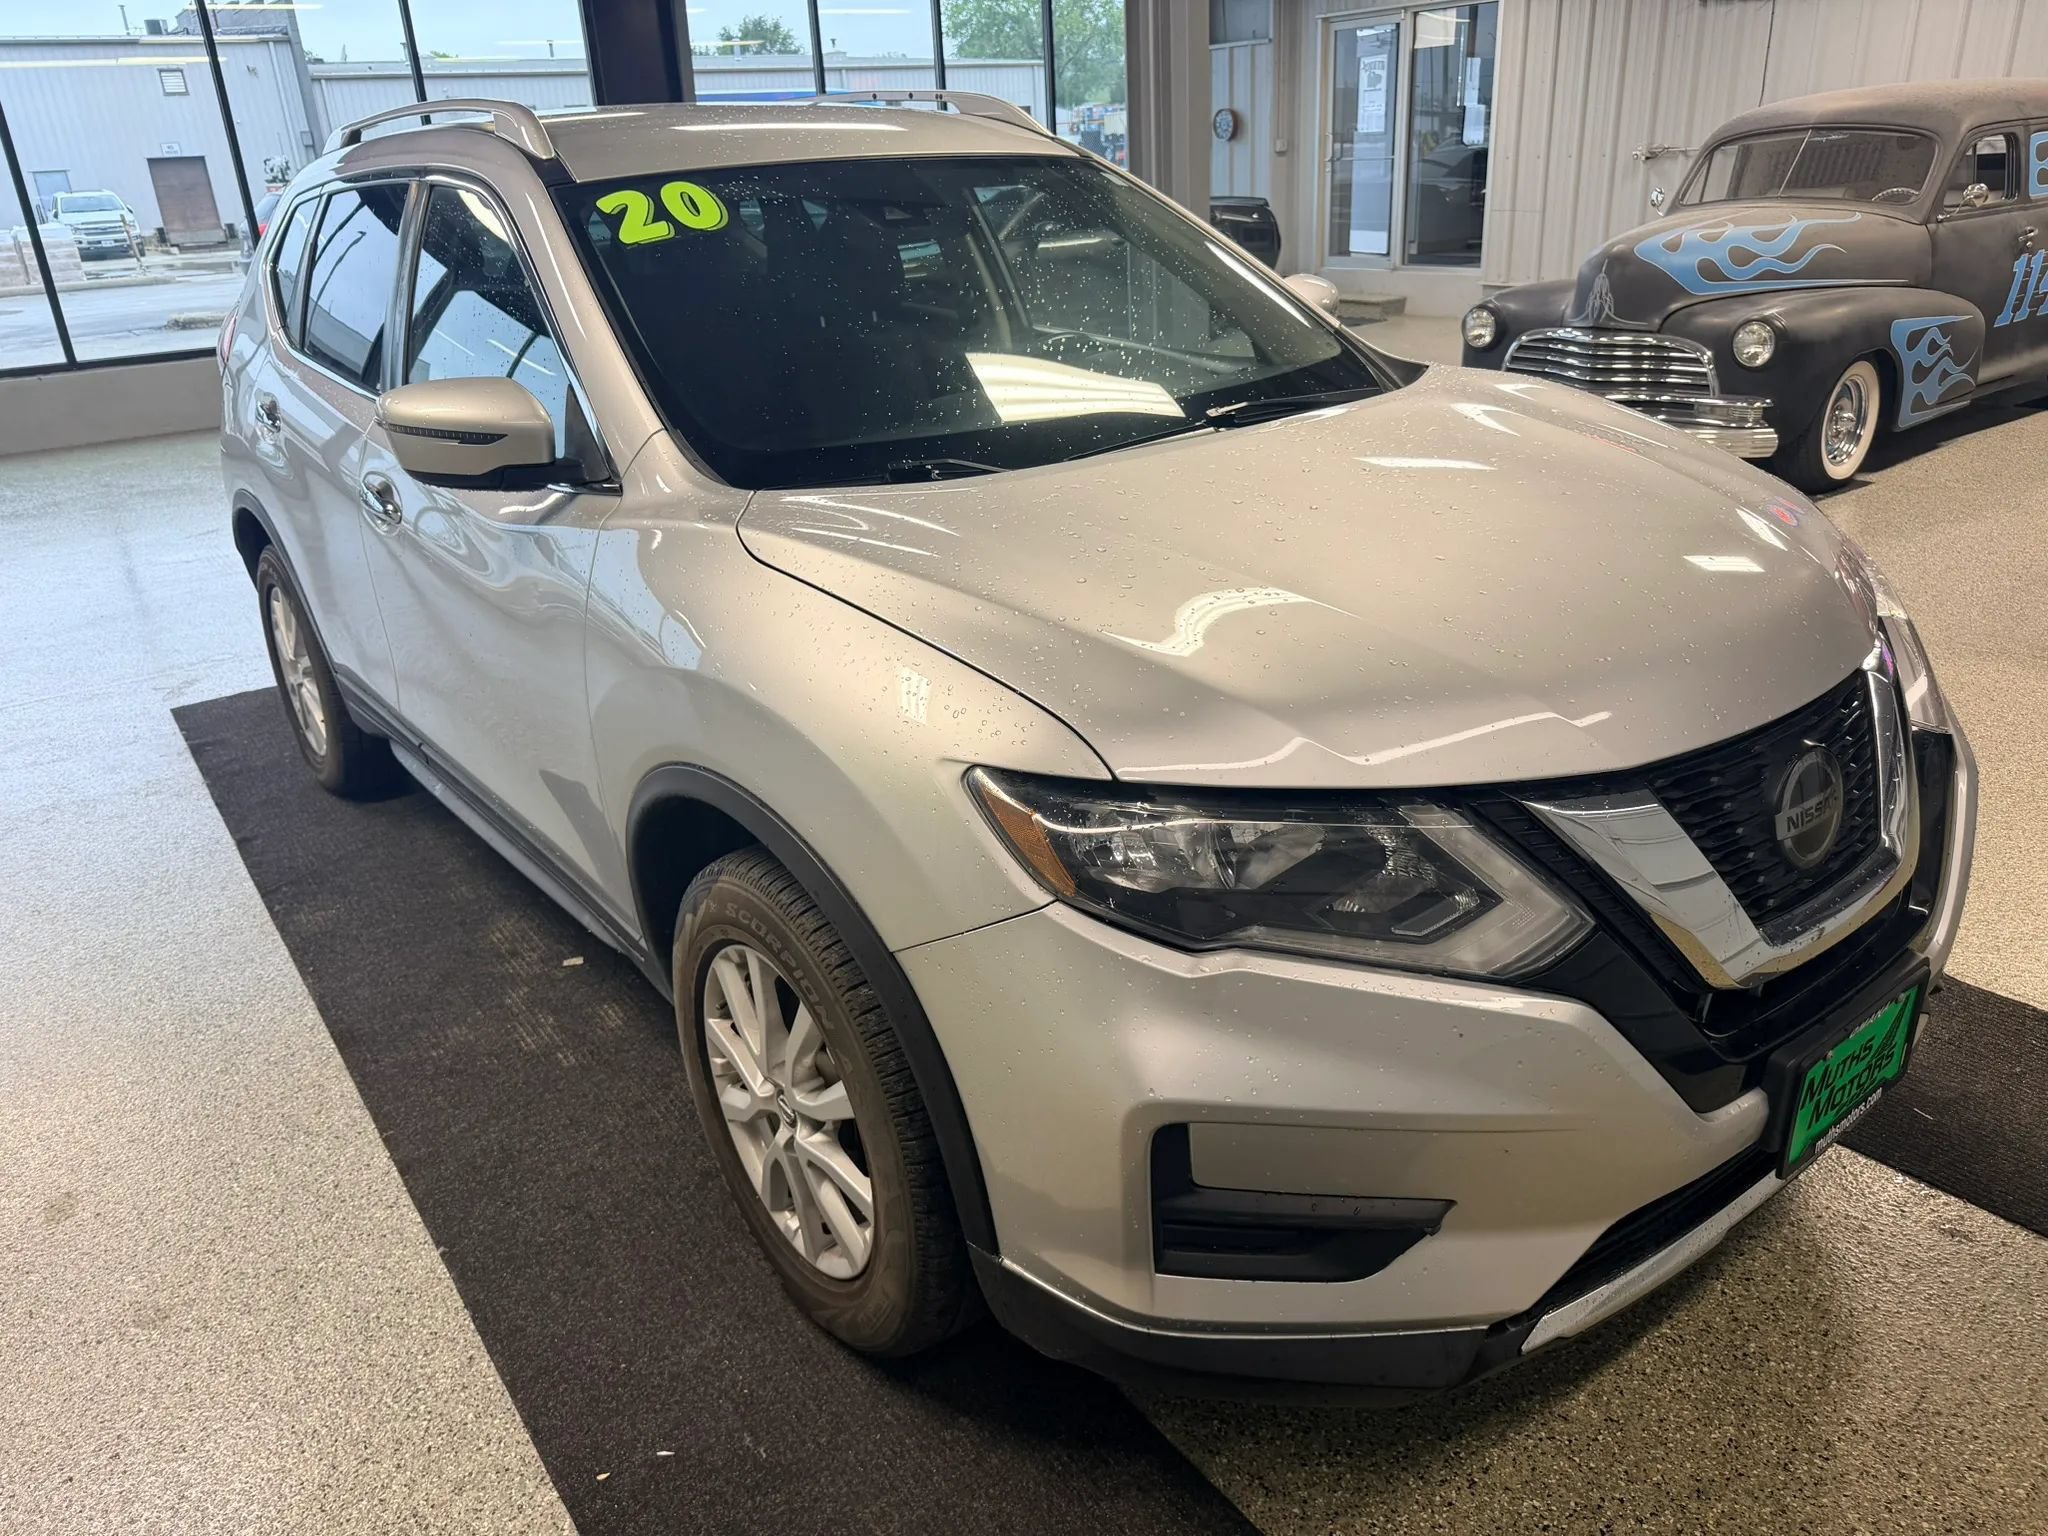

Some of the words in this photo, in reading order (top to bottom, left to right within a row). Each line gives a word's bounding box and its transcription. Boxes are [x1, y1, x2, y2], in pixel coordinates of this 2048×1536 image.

[596, 181, 728, 245] 20
[725, 902, 835, 1030] SCORPION
[1807, 1041, 1897, 1132] MOTORS
[1815, 1087, 1882, 1154] muthsmotors.com
